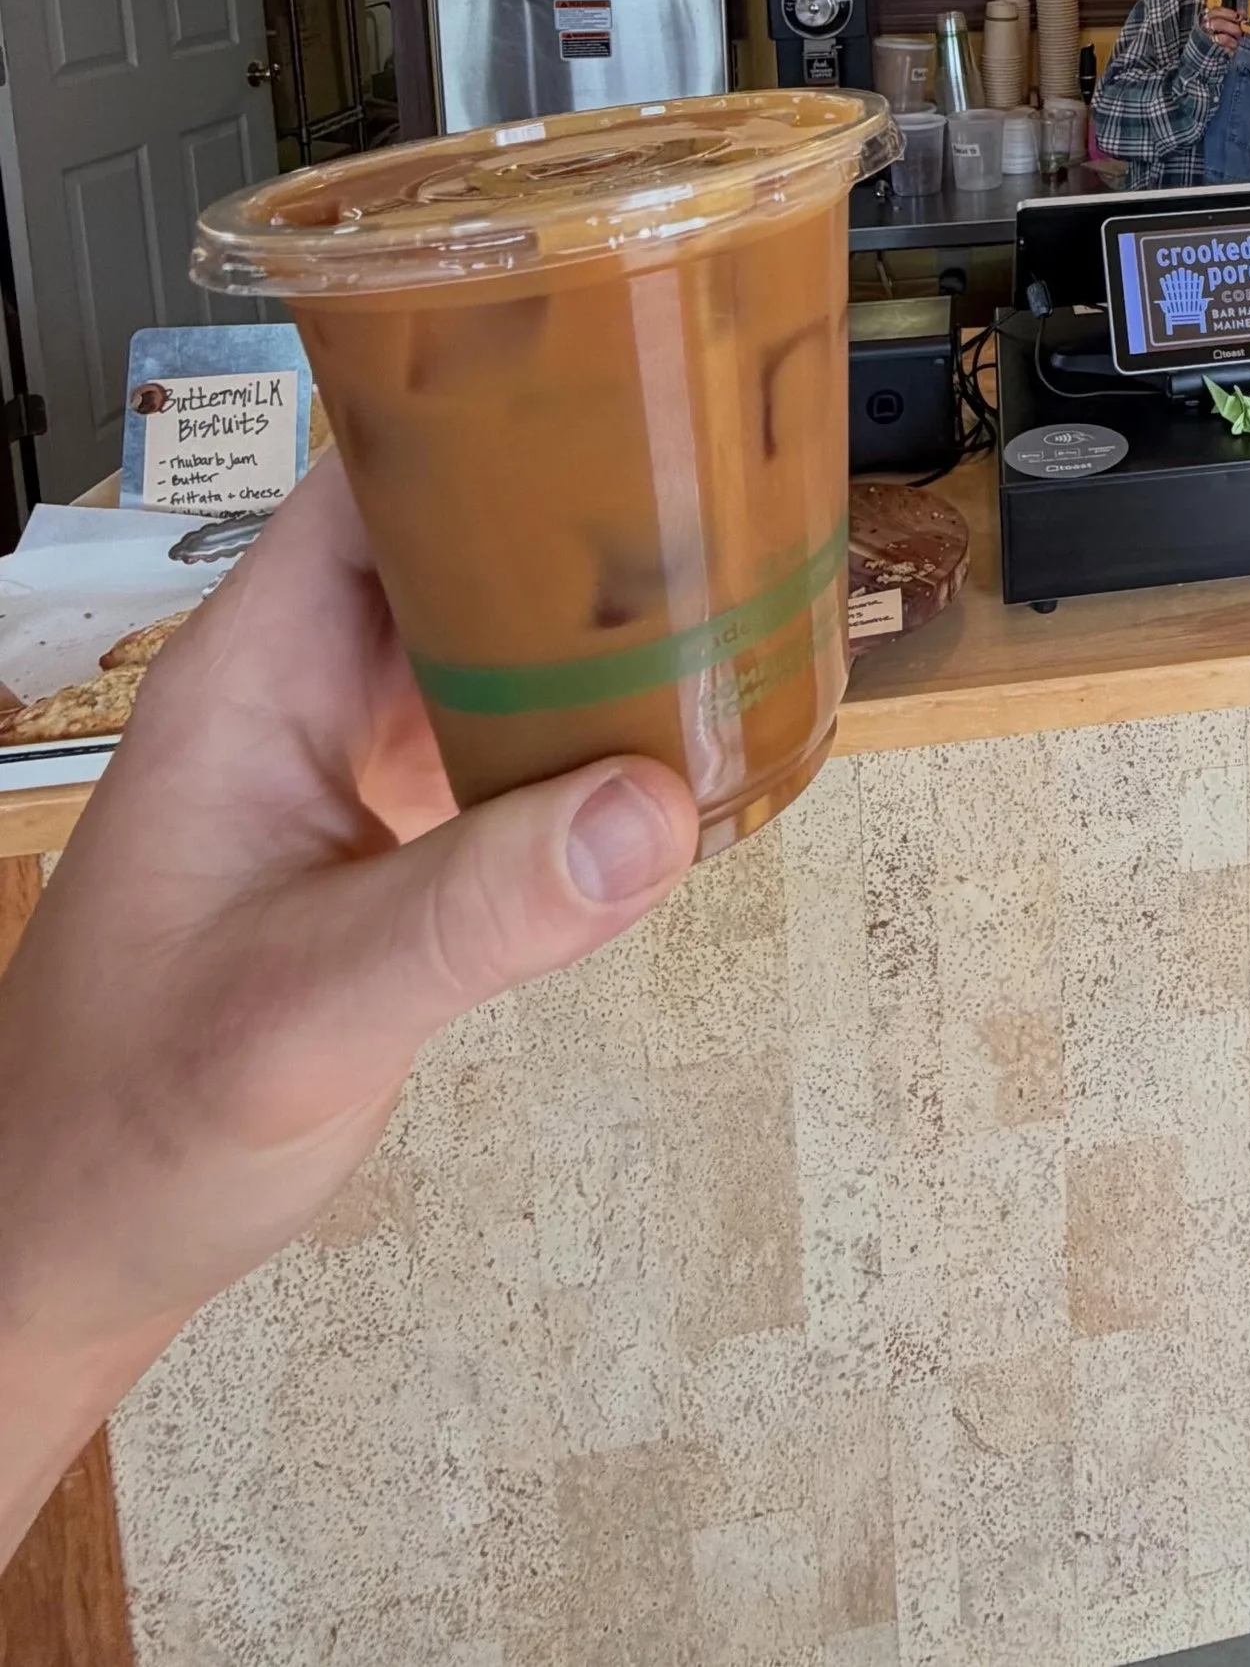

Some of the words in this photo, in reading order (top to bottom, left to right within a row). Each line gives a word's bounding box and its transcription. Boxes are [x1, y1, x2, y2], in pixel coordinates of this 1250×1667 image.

[1211, 307, 1236, 319] BAR
[1222, 349, 1245, 359] toast
[169, 452, 225, 470] rhubarb
[225, 453, 258, 470] jam
[239, 487, 284, 499] cheese
